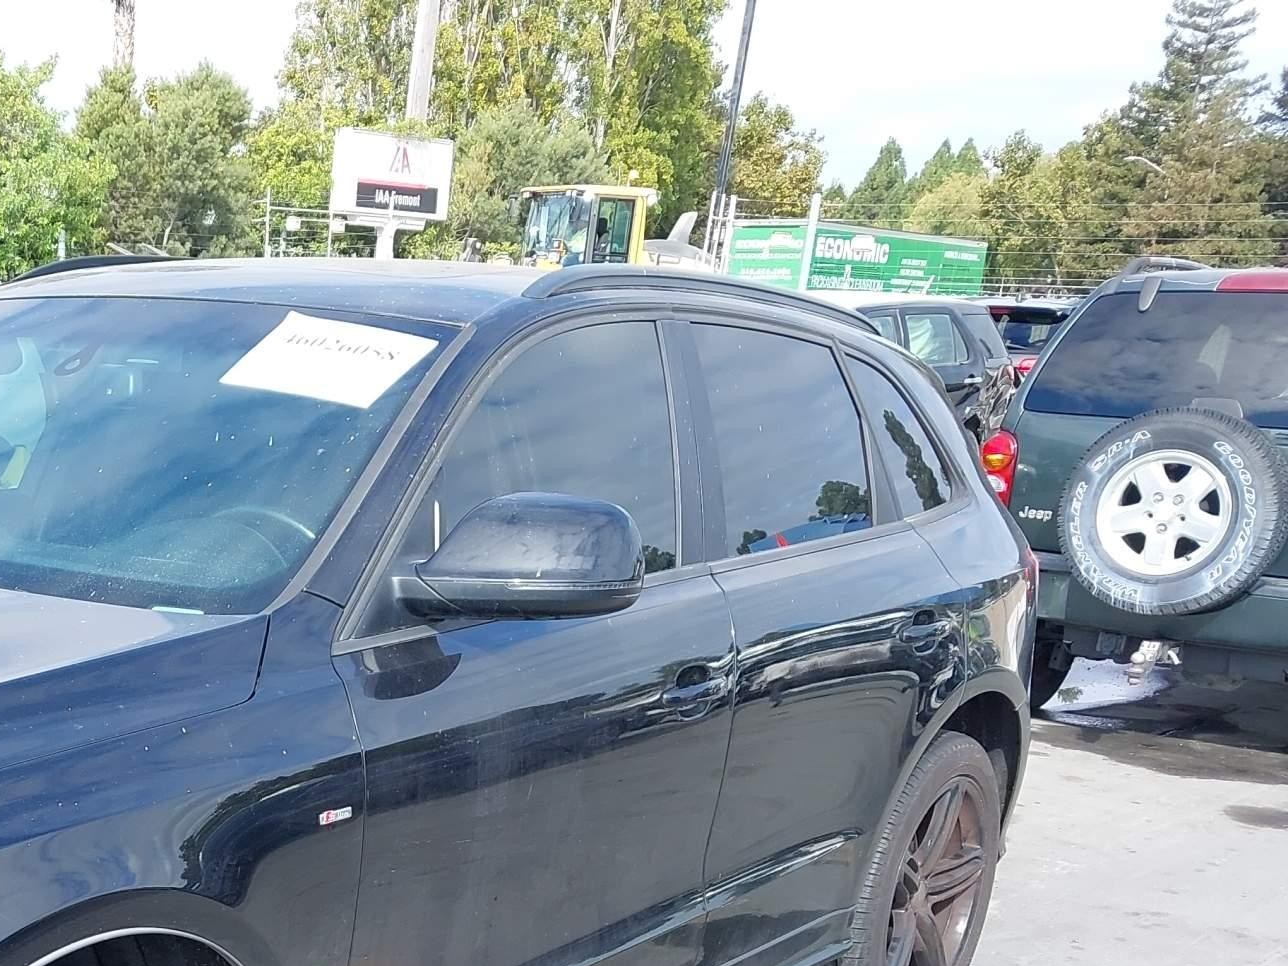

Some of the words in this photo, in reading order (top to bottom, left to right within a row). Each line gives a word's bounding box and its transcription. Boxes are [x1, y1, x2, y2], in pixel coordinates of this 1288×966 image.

[374, 188, 390, 204] IAA
[391, 191, 421, 207] Fremont
[814, 236, 890, 264] ECONOMIC
[1090, 430, 1152, 473] SR-A
[1018, 505, 1053, 522] Jeep
[1207, 440, 1257, 581] GOODYEAR
[1068, 481, 1140, 600] WRANGLER
